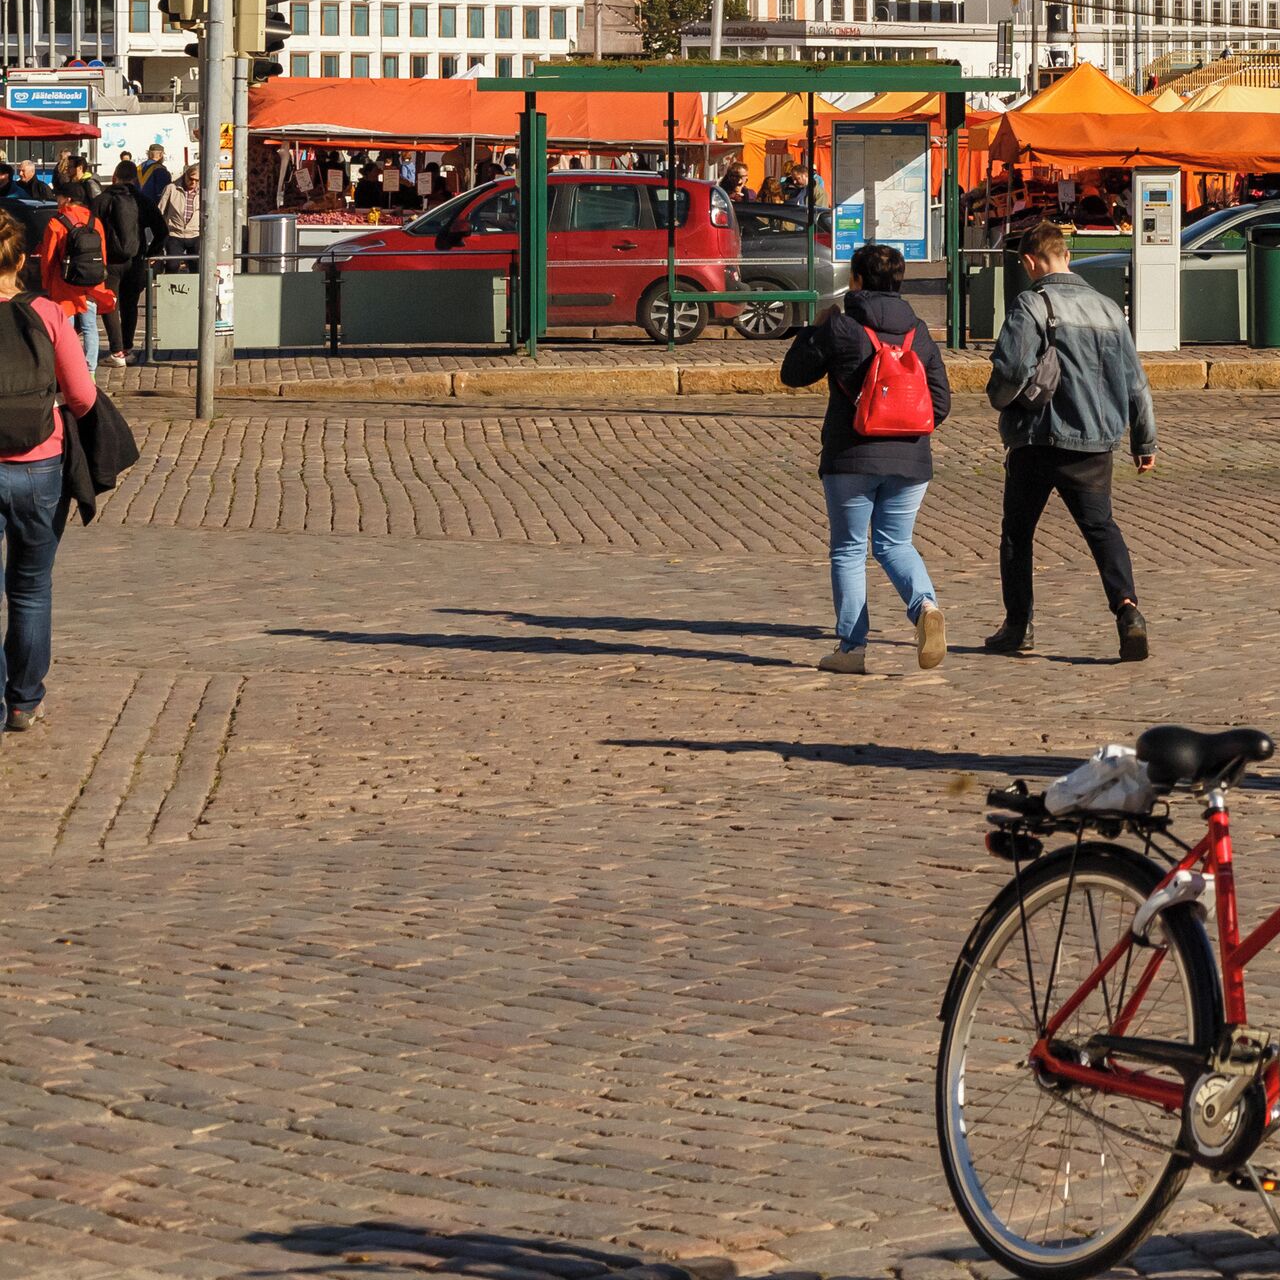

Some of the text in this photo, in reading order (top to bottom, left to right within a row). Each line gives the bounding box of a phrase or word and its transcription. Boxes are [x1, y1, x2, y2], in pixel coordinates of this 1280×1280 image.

[808, 26, 861, 36] FLYING CINEMA
[32, 91, 82, 100] Jäätelökioski
